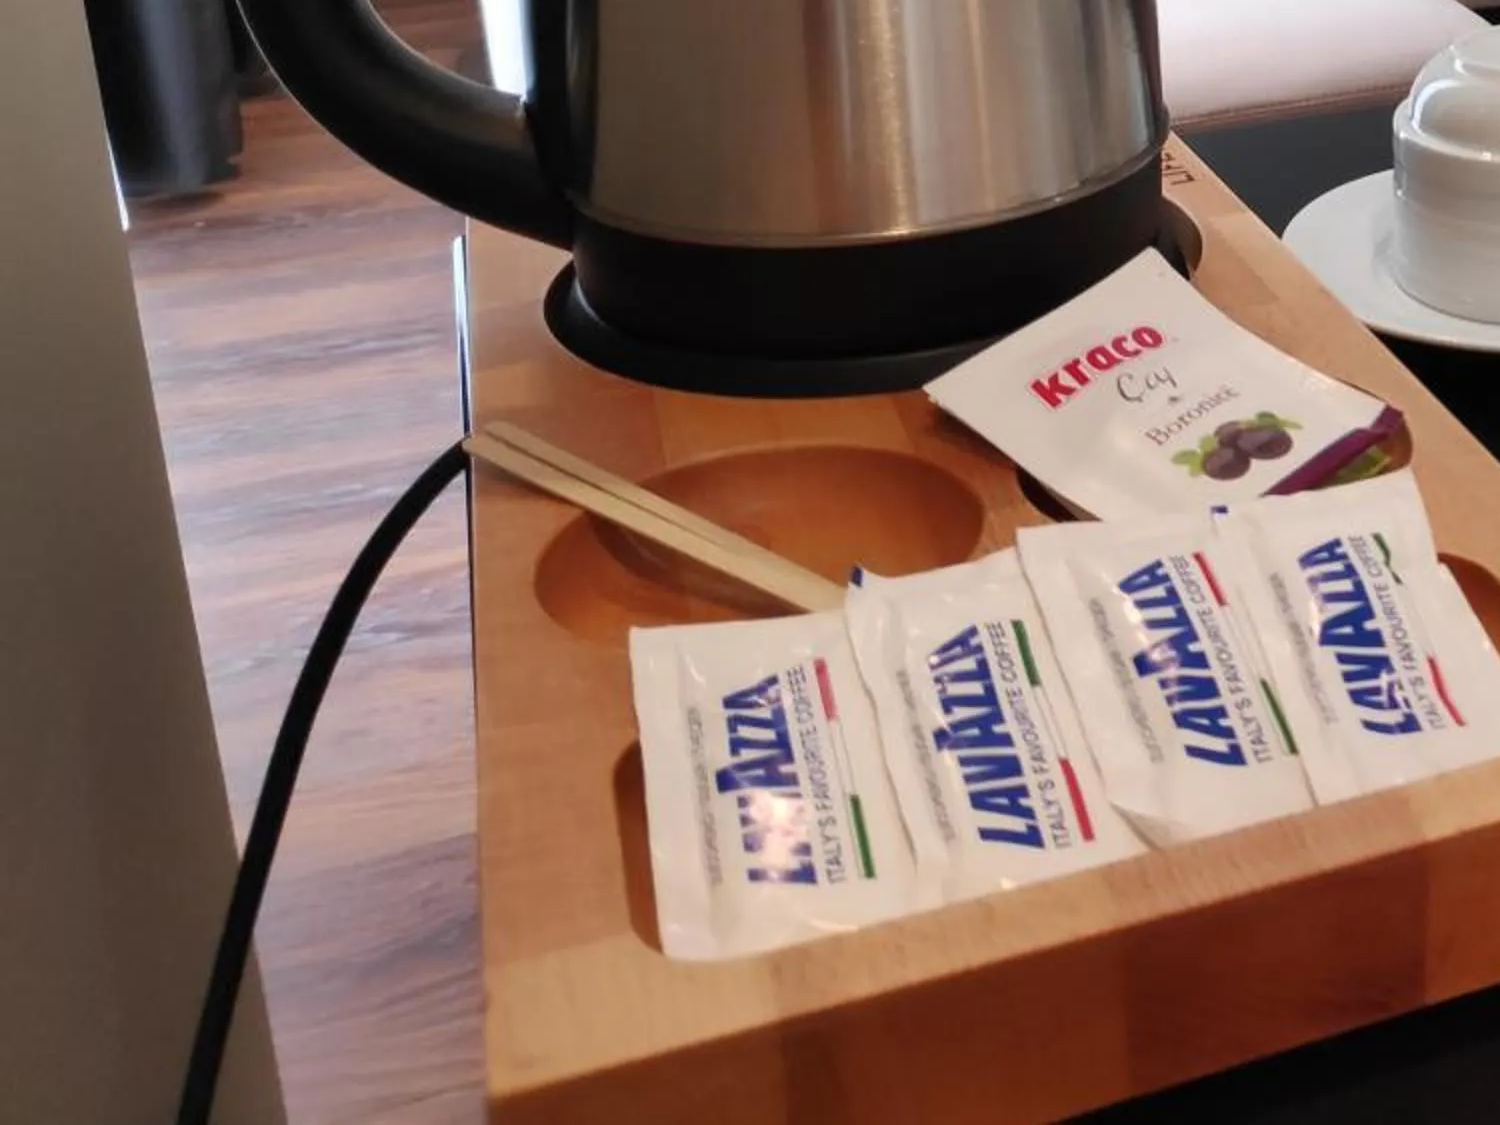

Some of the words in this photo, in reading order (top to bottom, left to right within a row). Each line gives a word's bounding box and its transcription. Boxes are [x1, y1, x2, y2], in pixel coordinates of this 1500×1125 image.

[1030, 326, 1163, 409] kraco
[1168, 553, 1206, 605] COFFEE
[1346, 534, 1383, 579] COFFEE
[984, 620, 1019, 684] COFFEE
[1117, 558, 1247, 764] LAVAZZA
[1196, 607, 1246, 695] FAVOURITE
[1297, 537, 1422, 734] LAVAZZA
[1371, 580, 1418, 670] FAVOURITE
[786, 663, 814, 723] COFFEE
[1004, 685, 1050, 776] FAVOURITE
[1234, 696, 1275, 763] ITALY'S
[799, 727, 832, 811] FAVOURITE
[926, 625, 1045, 847] LAVAZZA
[713, 674, 817, 884] LAZZA
[1036, 778, 1072, 849] ITALY'S
[815, 815, 847, 884] ITALY'S
